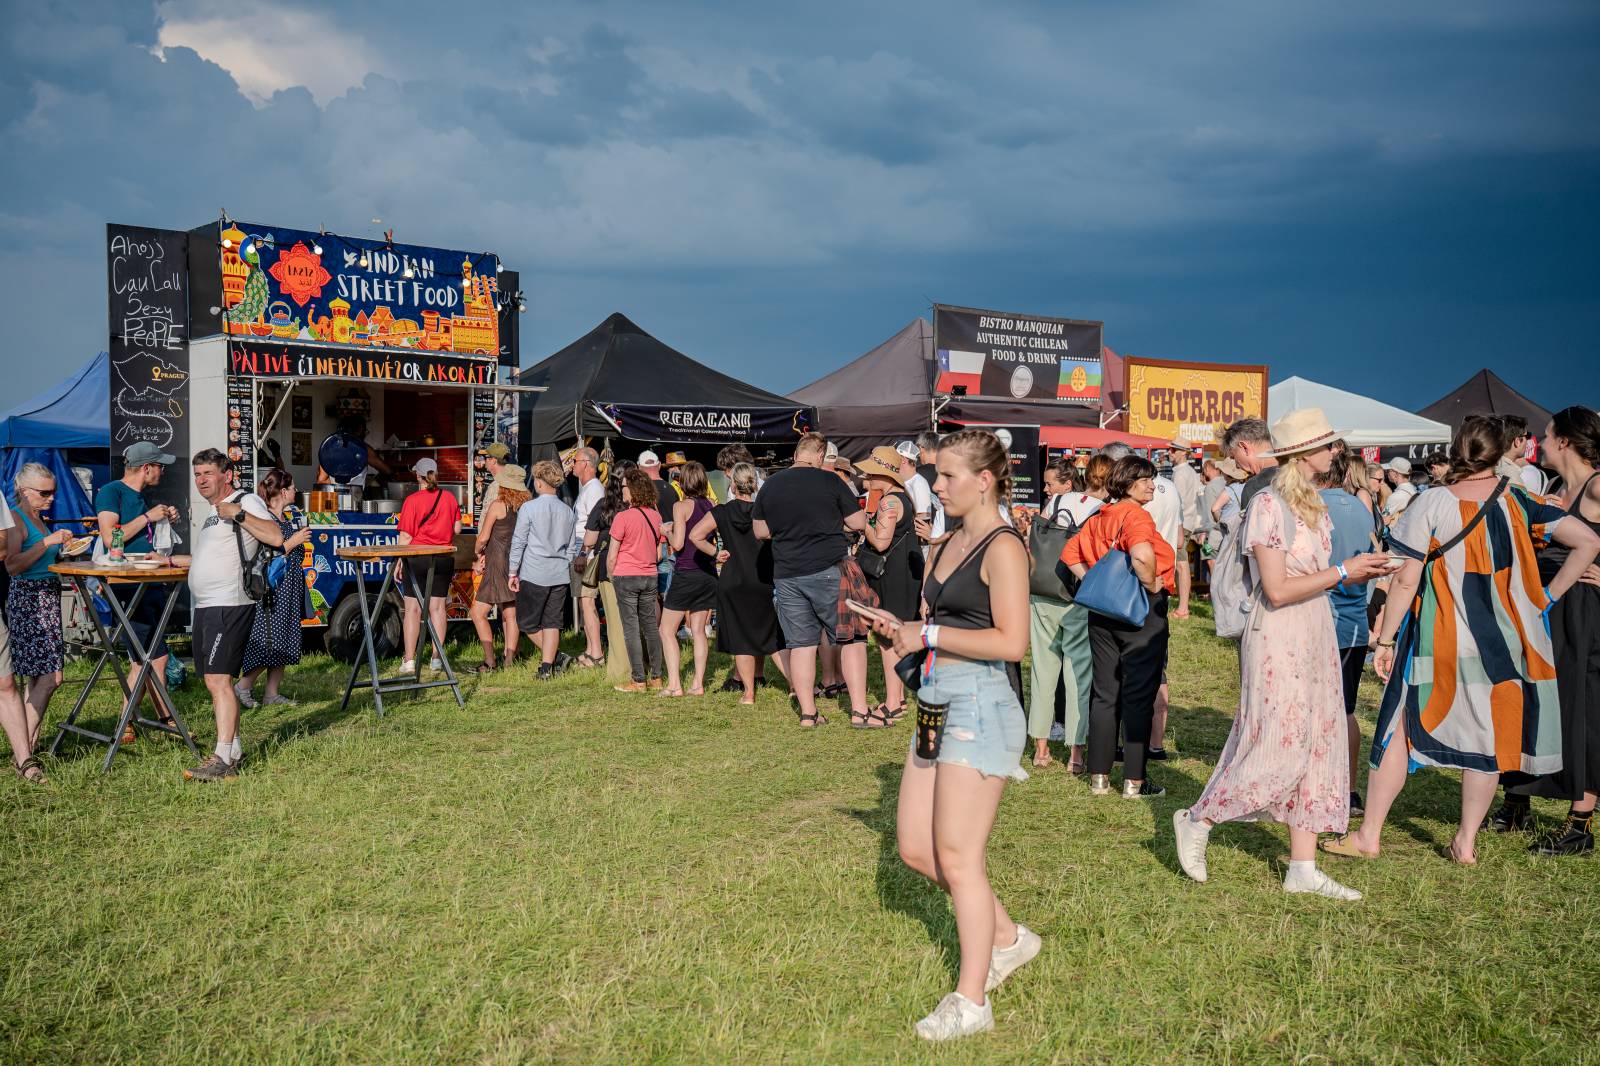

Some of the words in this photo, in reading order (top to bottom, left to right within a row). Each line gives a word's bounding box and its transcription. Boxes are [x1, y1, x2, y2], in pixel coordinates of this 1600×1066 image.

[366, 250, 435, 280] INDIAN
[337, 273, 407, 306] STREET
[413, 281, 458, 307] FOOD
[126, 292, 173, 323] Sexy
[979, 316, 1014, 331] BISTRO
[1015, 320, 1064, 335] MANQUIAN
[976, 332, 1028, 348] AUTHENTIC
[1028, 337, 1068, 350] CHILEAN
[991, 349, 1016, 362] FOOD
[1018, 352, 1026, 363] &
[1027, 353, 1058, 365] DRINK
[403, 362, 422, 382] OR
[1147, 387, 1245, 424] CHURROS
[659, 411, 751, 428] REBACANO
[335, 560, 374, 576] STRET
